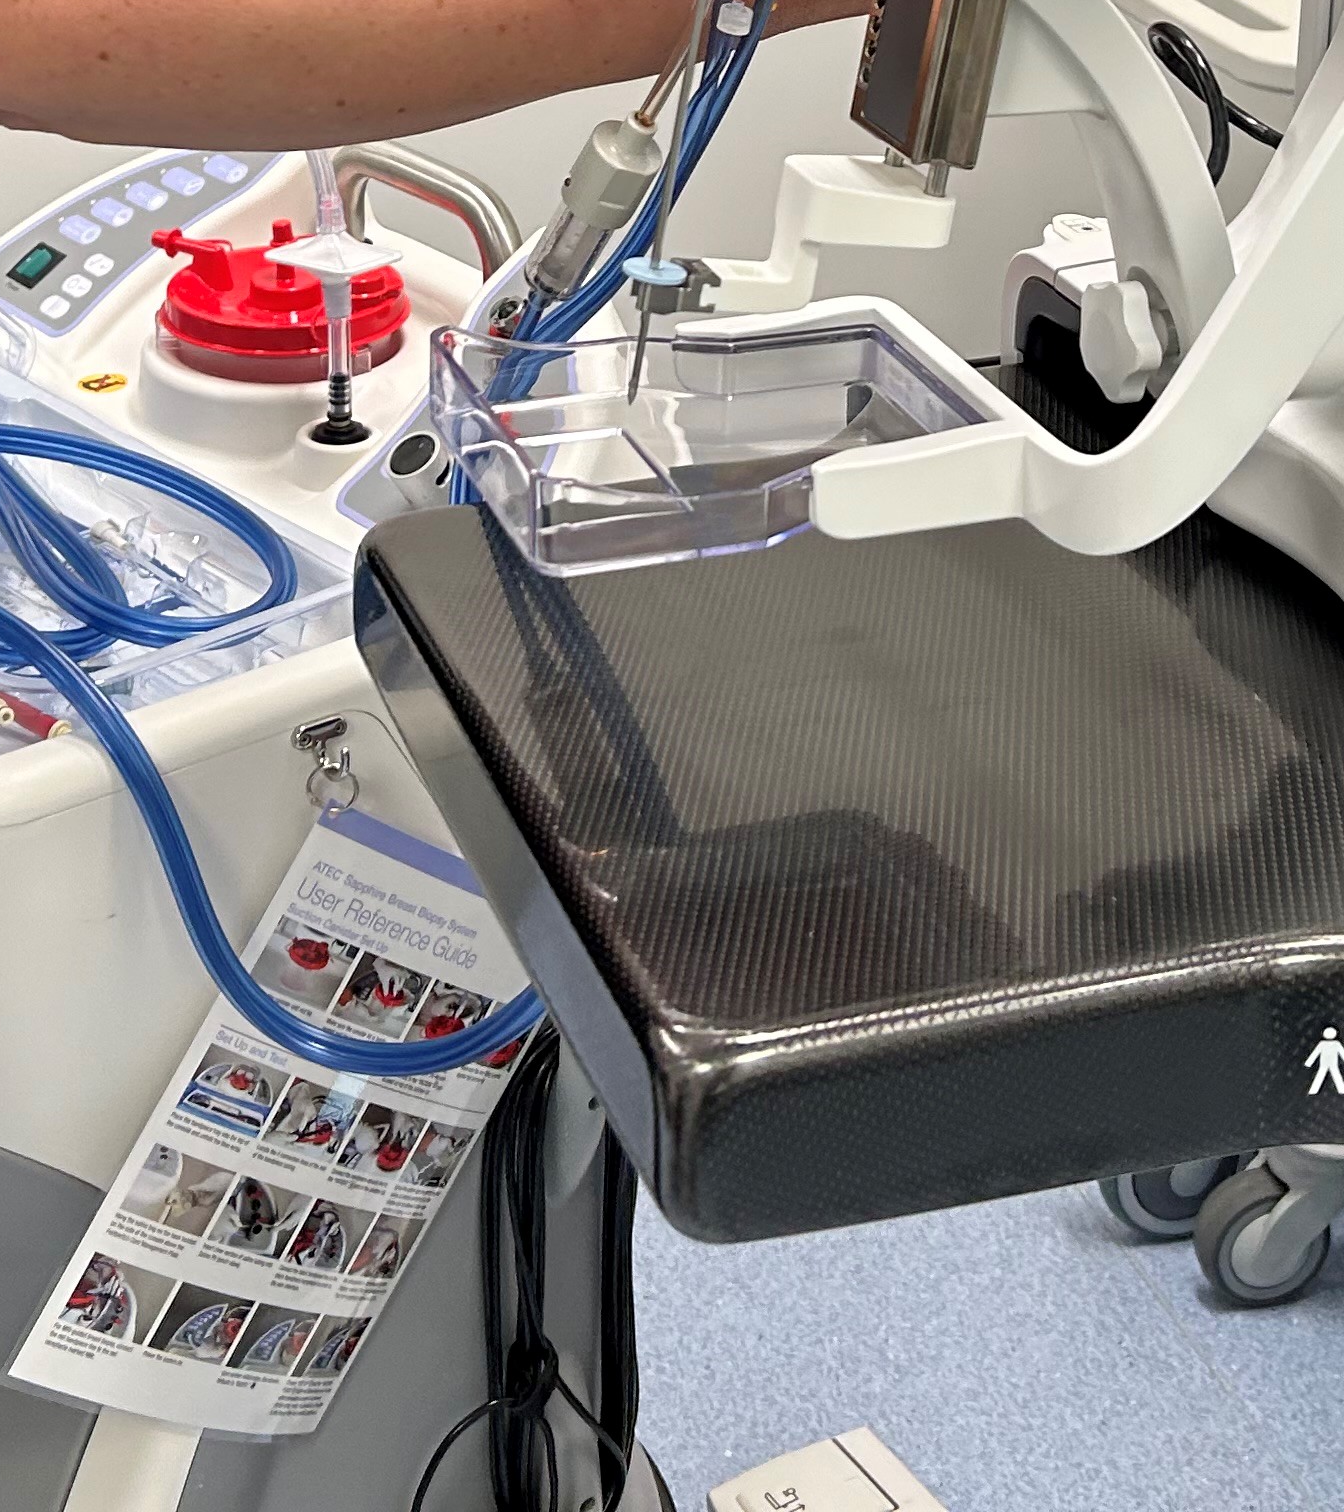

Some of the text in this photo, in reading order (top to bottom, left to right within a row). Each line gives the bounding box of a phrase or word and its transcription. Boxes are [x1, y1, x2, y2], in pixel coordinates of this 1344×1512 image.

[287, 902, 389, 954] Suction Canister Set Up
[297, 876, 478, 970] User Reference Guide
[312, 861, 478, 938] ATEC Sapphire Breast Biopsy System
[215, 1030, 289, 1067] Set Up and Test
